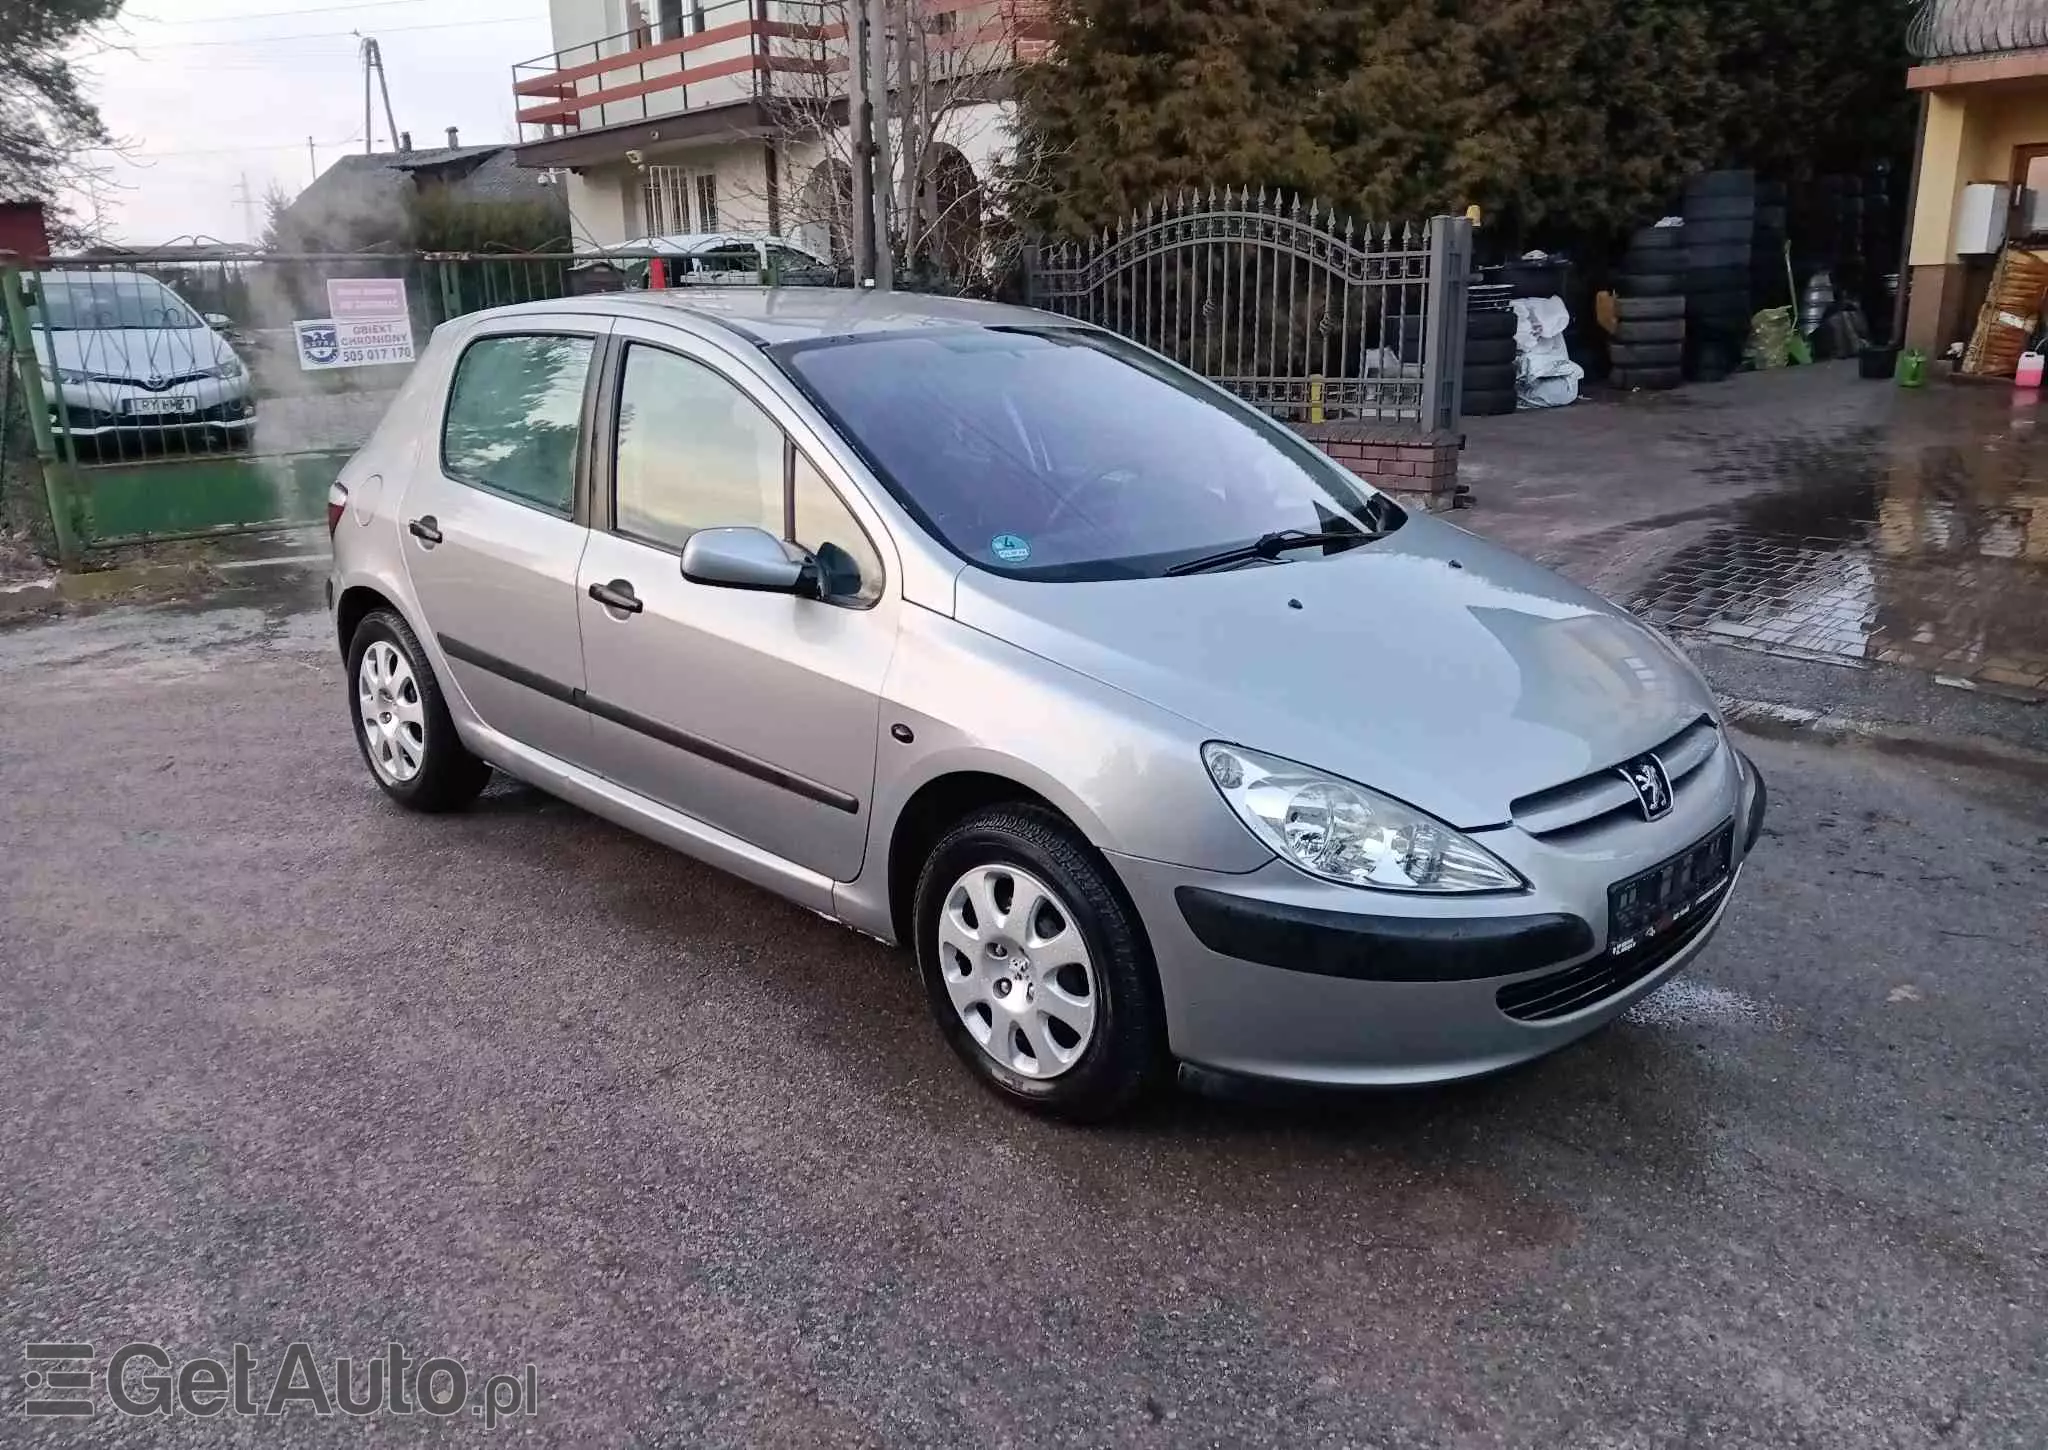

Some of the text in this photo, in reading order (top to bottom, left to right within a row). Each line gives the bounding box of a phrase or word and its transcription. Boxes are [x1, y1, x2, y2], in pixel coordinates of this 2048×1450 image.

[353, 325, 393, 335] OBIEKT
[343, 351, 363, 362] 505
[367, 349, 386, 360] 017
[392, 347, 411, 358] 170
[1004, 536, 1015, 548] 4
